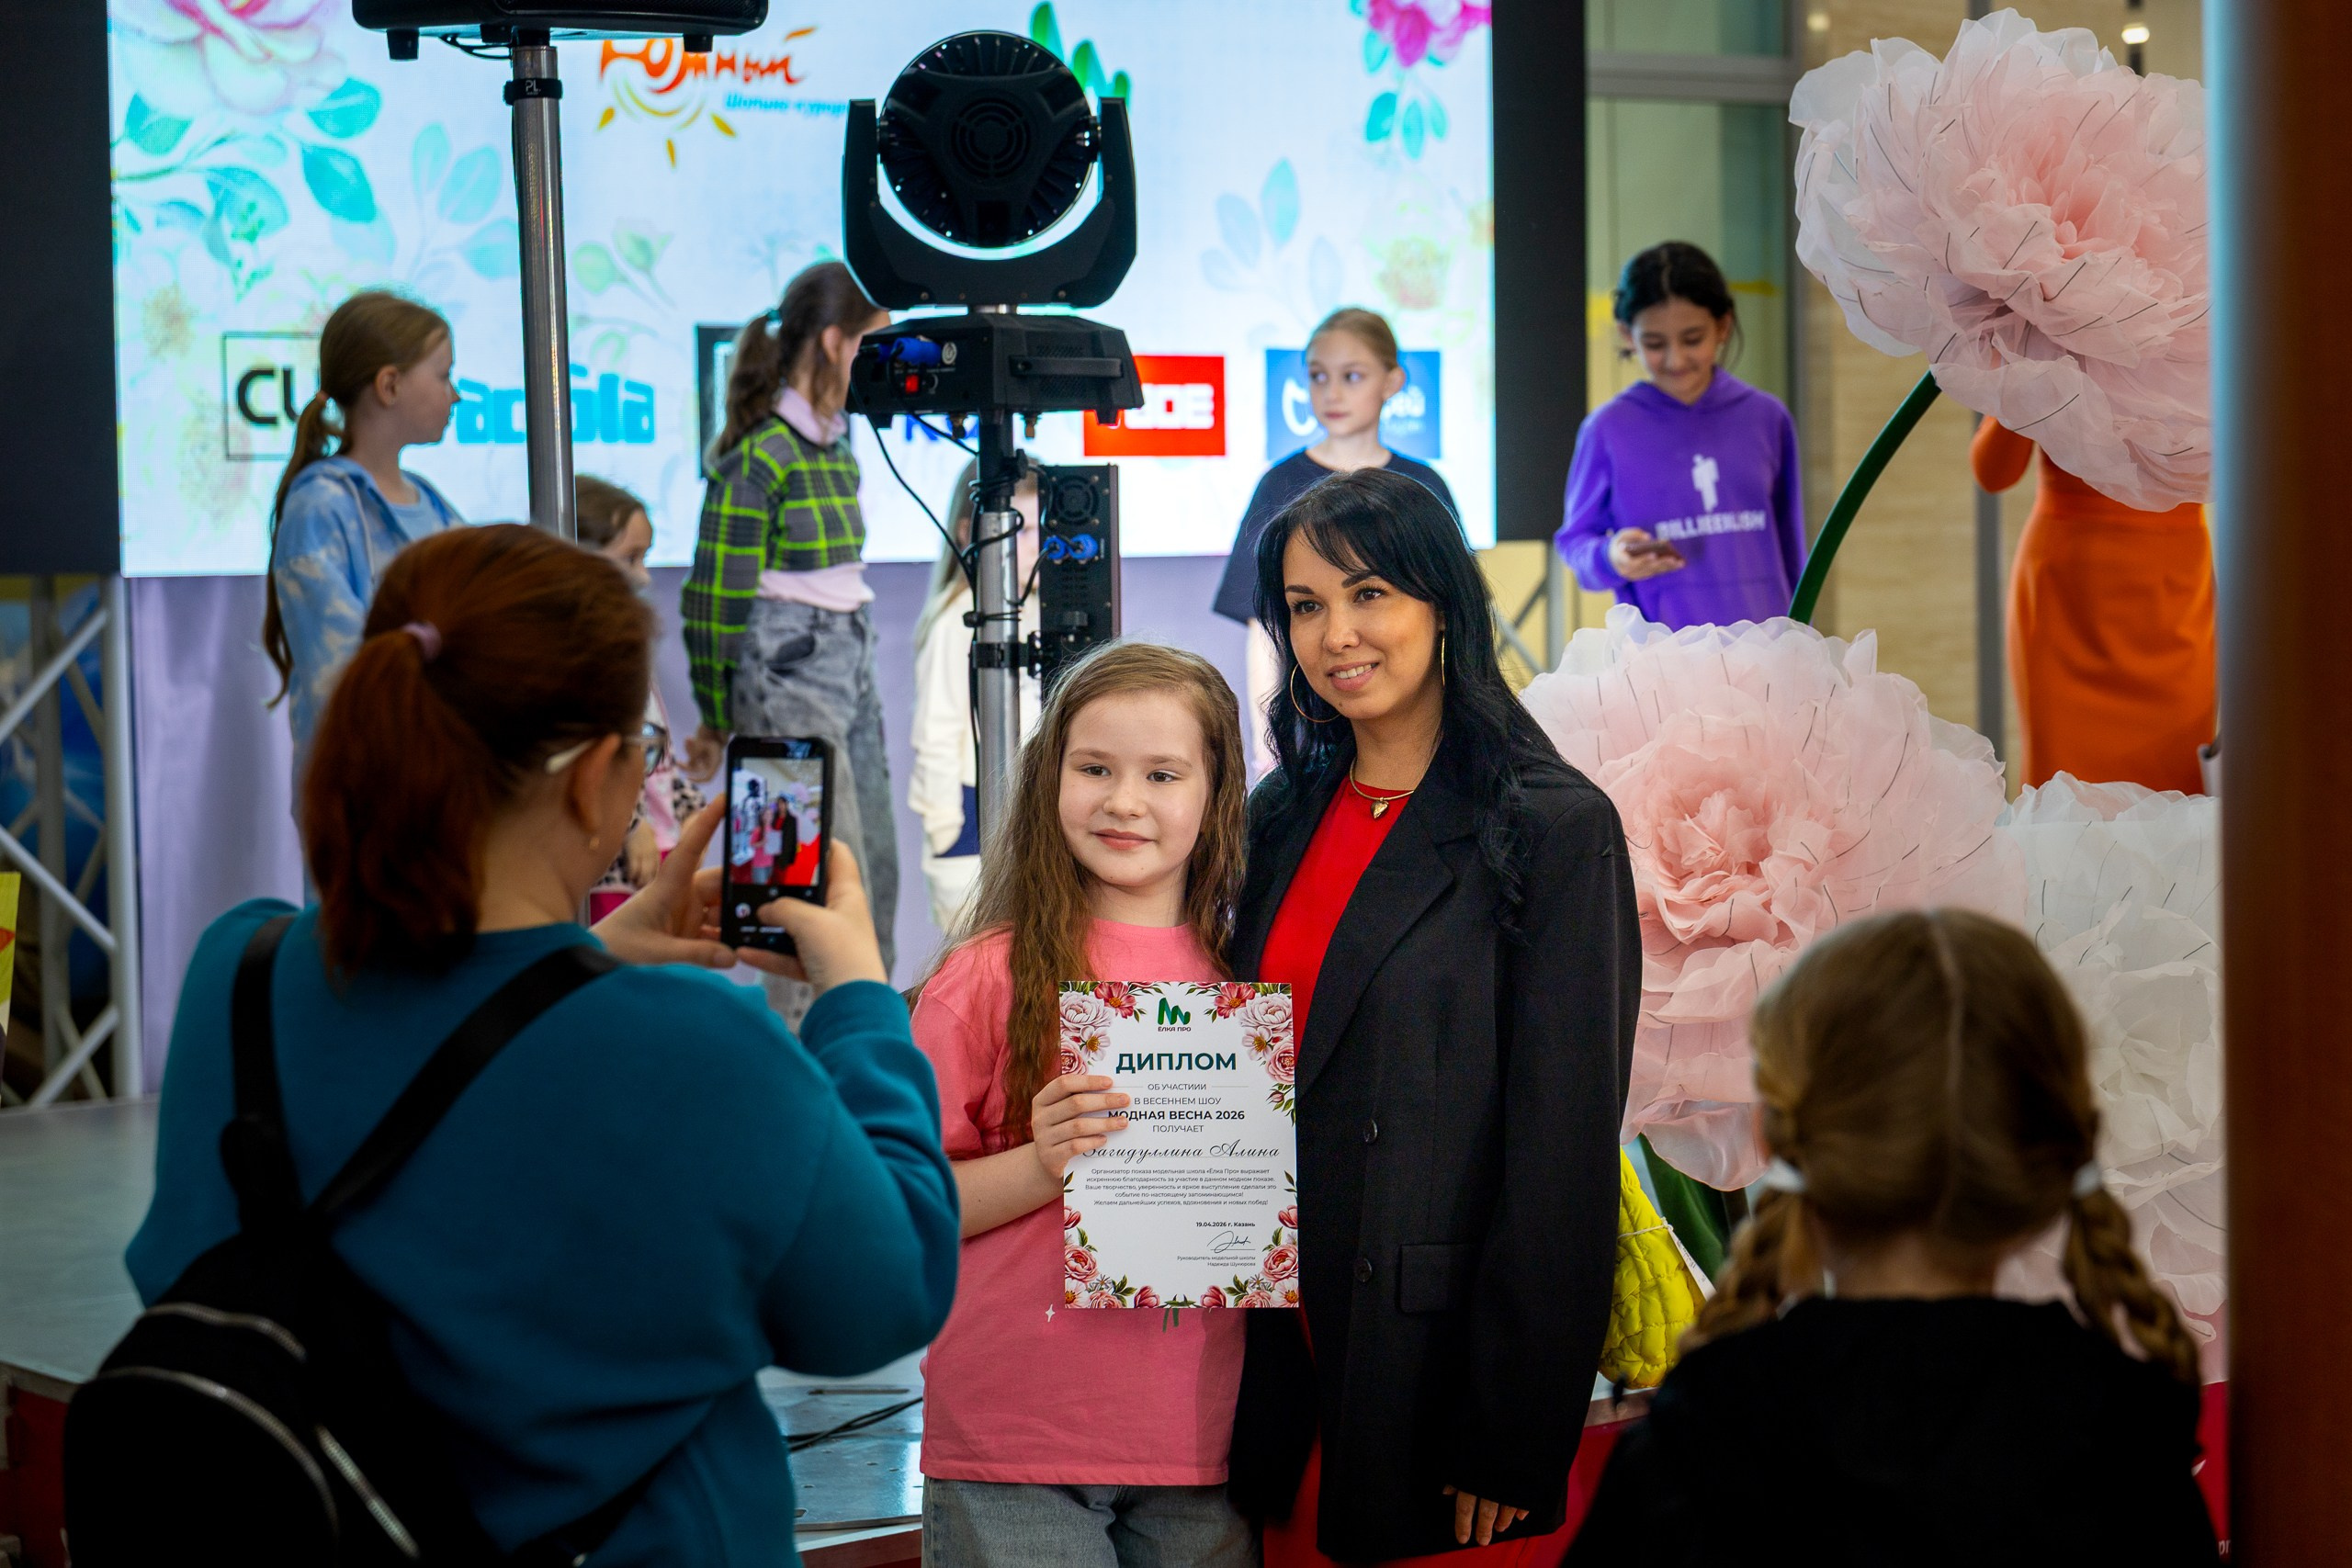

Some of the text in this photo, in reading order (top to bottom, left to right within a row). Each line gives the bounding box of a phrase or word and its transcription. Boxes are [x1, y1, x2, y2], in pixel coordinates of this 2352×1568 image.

[1115, 1052, 1237, 1074] ДИПЛОМ
[1148, 1083, 1207, 1091] ОБ УЧАСТИИИ
[1134, 1097, 1222, 1105] В ВЕСЕННЕМ ШОУ
[1169, 1110, 1213, 1120] ВЕСНА
[1216, 1110, 1245, 1121] 2026
[1152, 1124, 1204, 1133] ПОЛУЧАЕТ
[1209, 1138, 1280, 1157] Алина
[1091, 1168, 1130, 1176] Организатор
[1131, 1168, 1152, 1176] показа
[1152, 1168, 1185, 1176] модельная
[1186, 1168, 1205, 1176] школа
[1240, 1168, 1271, 1176] выражает
